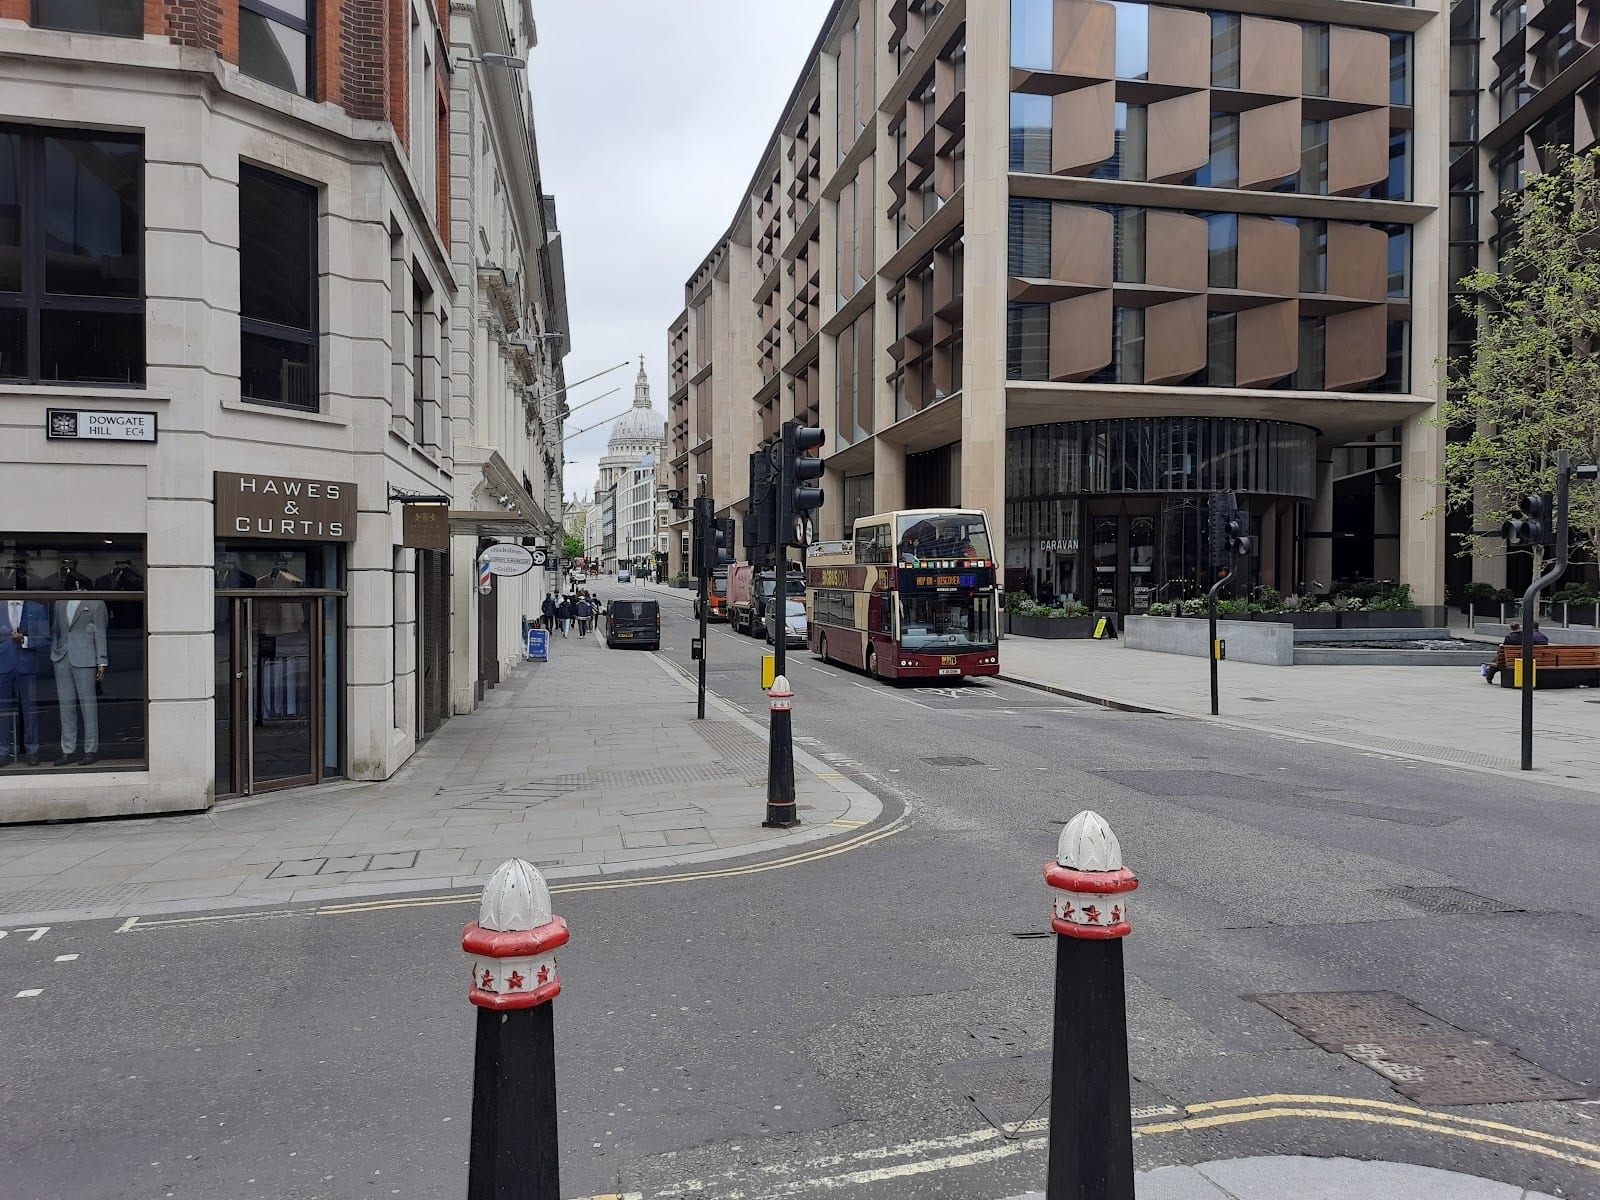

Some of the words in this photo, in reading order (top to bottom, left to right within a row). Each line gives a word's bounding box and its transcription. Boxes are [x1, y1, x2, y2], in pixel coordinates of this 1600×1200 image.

[89, 416, 145, 426] DOWGATE
[89, 427, 112, 436] HILL
[125, 427, 145, 436] EC4
[240, 477, 340, 500] HAWES
[284, 500, 300, 515] &
[235, 517, 343, 536] CURTIS
[1040, 539, 1079, 551] CARAVAN
